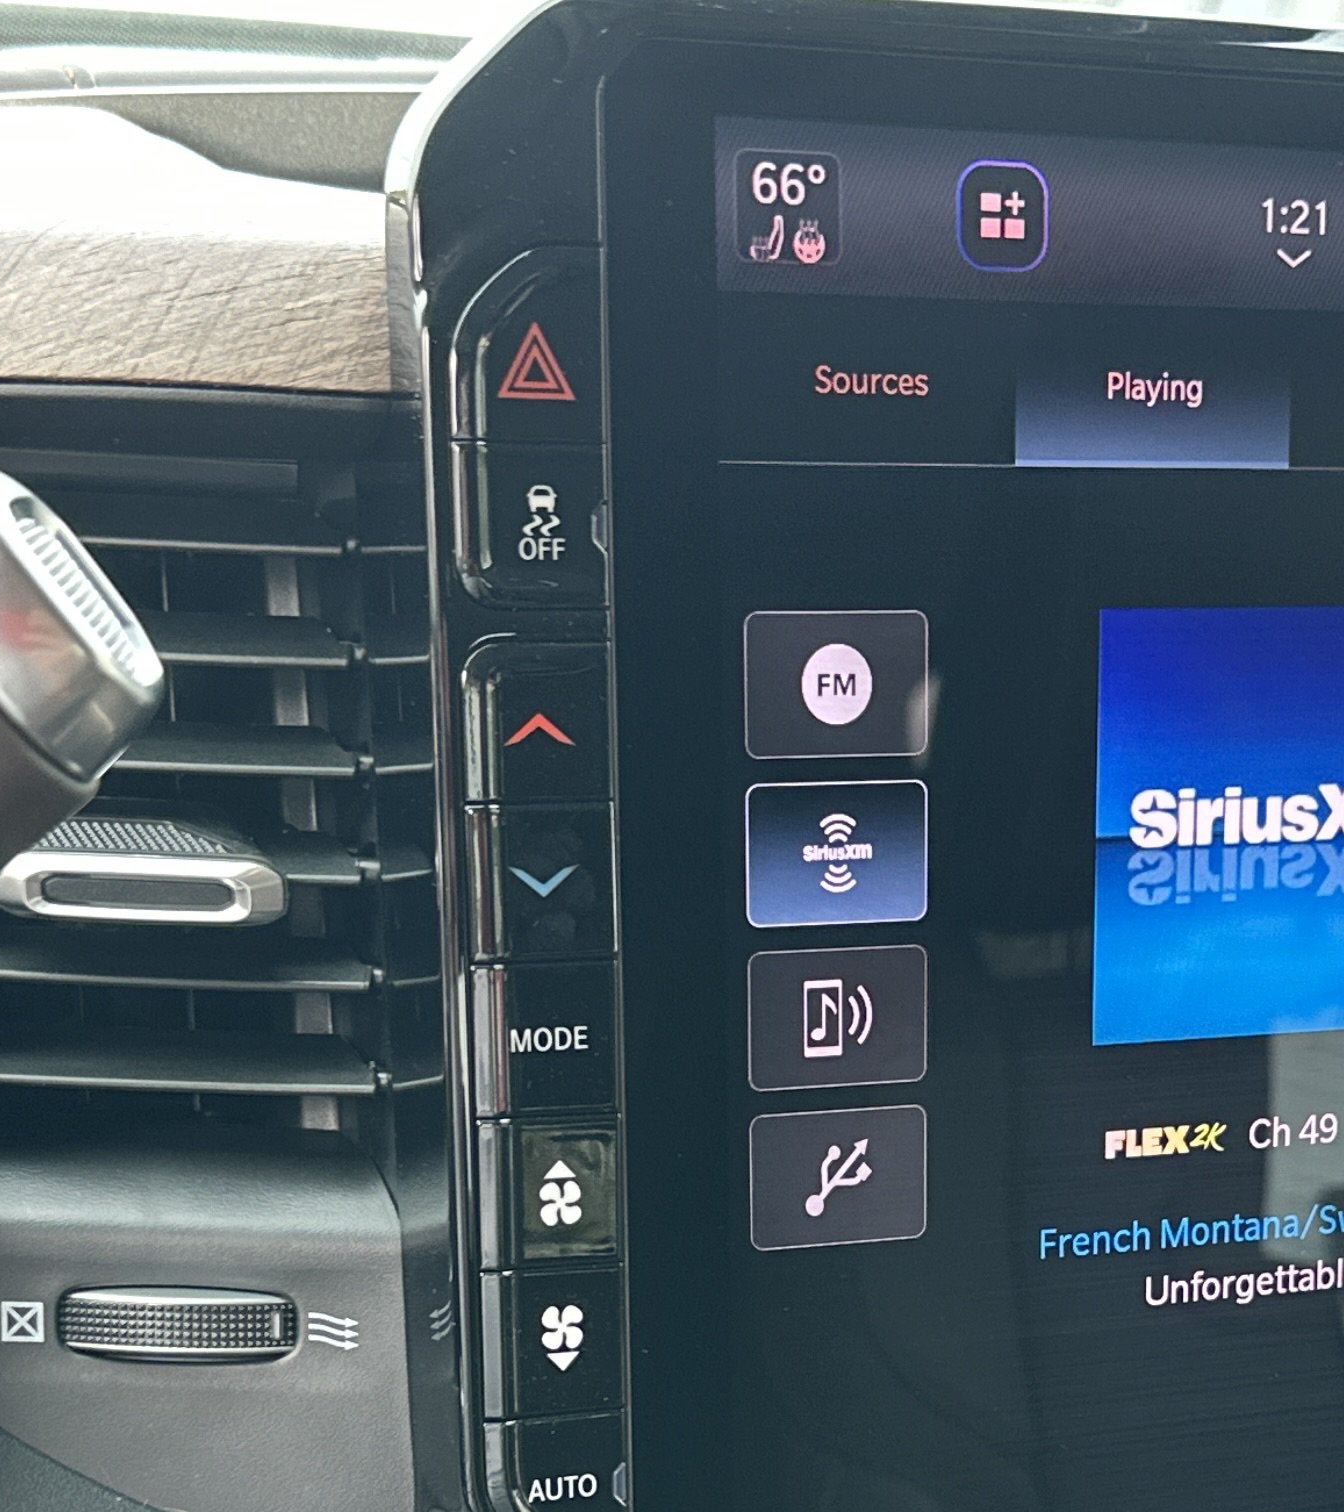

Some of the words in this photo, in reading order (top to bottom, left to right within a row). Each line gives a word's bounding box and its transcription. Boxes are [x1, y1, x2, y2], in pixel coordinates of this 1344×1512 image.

[752, 162, 826, 206] 66°
[1261, 197, 1328, 236] 1:21
[814, 365, 929, 397] Sources
[1107, 371, 1203, 408] Playing
[518, 538, 565, 560] OFF
[817, 673, 856, 696] FM
[510, 1025, 589, 1053] MODE
[1248, 1116, 1291, 1150] Ch
[1298, 1112, 1339, 1145] 49
[1039, 1221, 1151, 1260] French
[528, 1474, 598, 1503] AUTO
